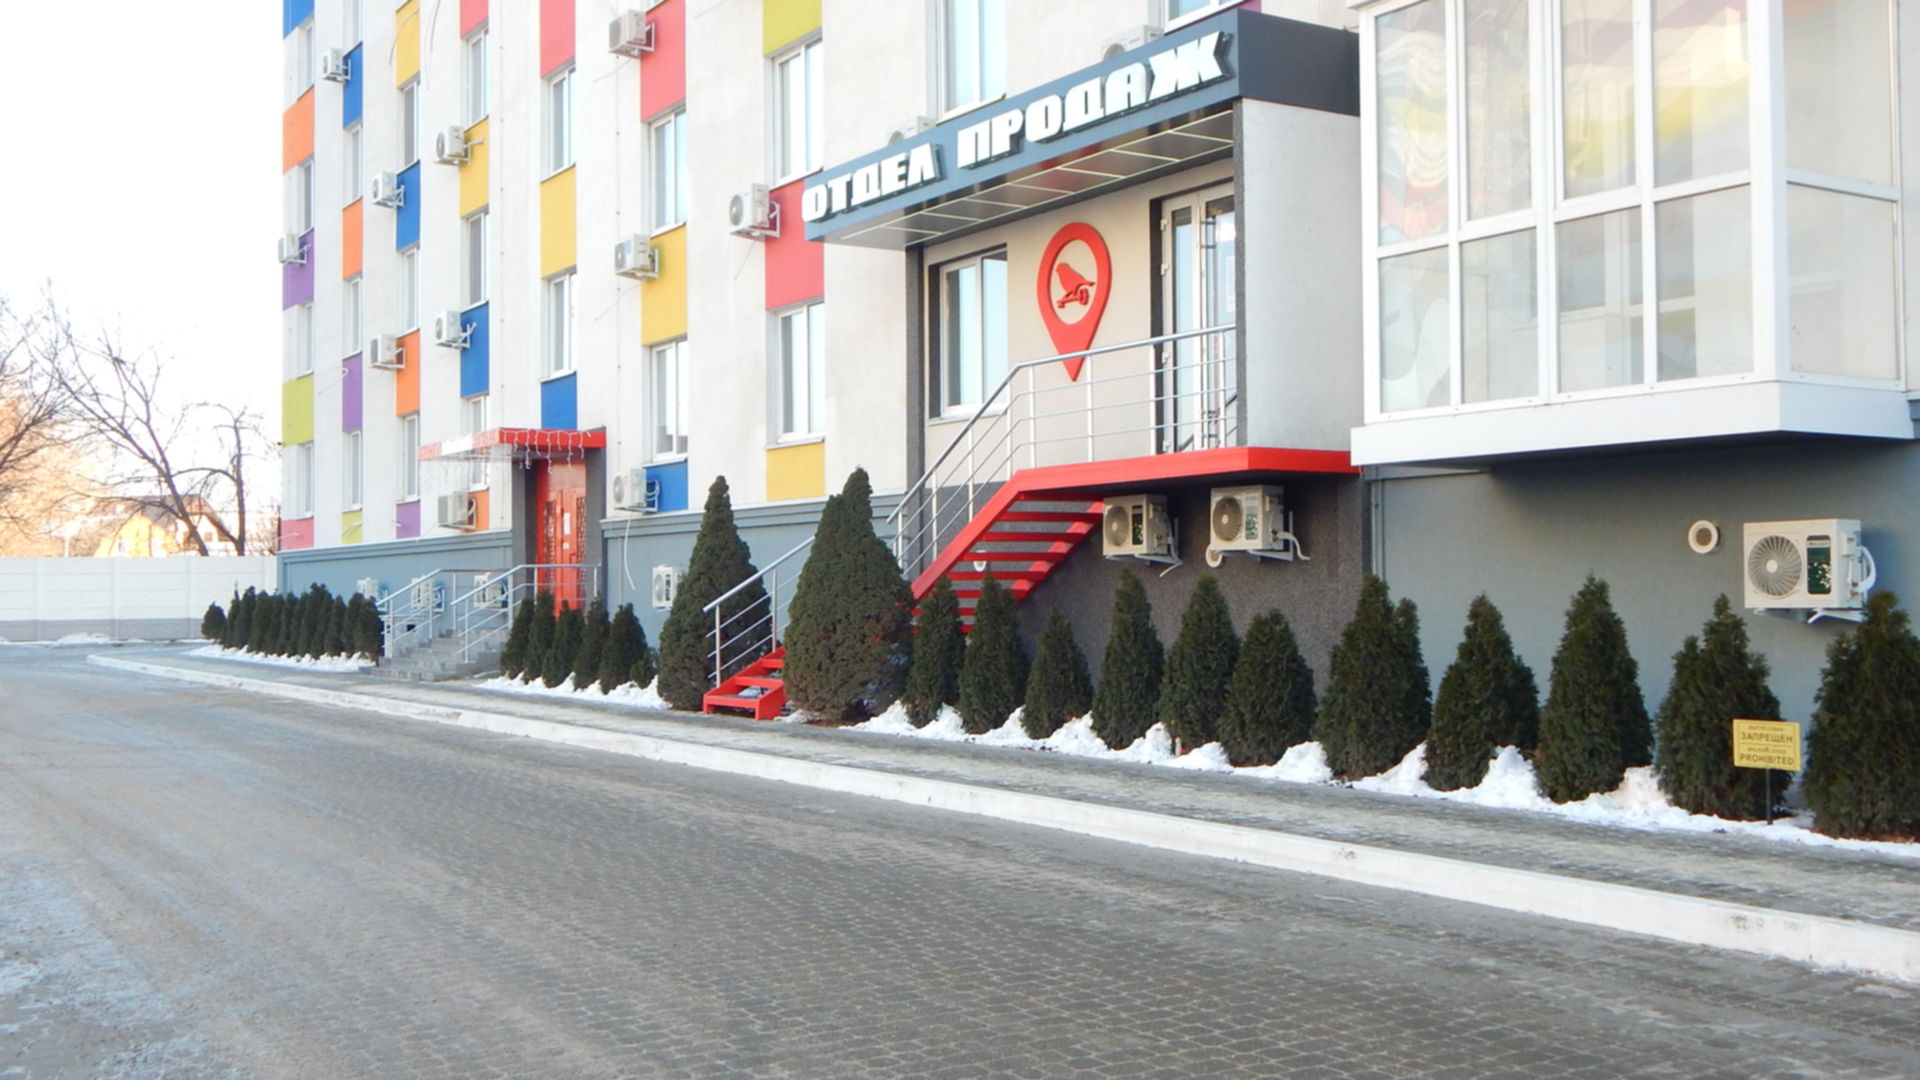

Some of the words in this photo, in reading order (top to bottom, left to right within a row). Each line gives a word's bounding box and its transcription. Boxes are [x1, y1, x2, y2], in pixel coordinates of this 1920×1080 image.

[801, 142, 938, 223] ОТДЕЛ
[957, 30, 1228, 169] ПРОДАЖ
[1741, 732, 1794, 743] ЗАПРЕЩЕН
[1740, 753, 1794, 766] PROHIBITED
